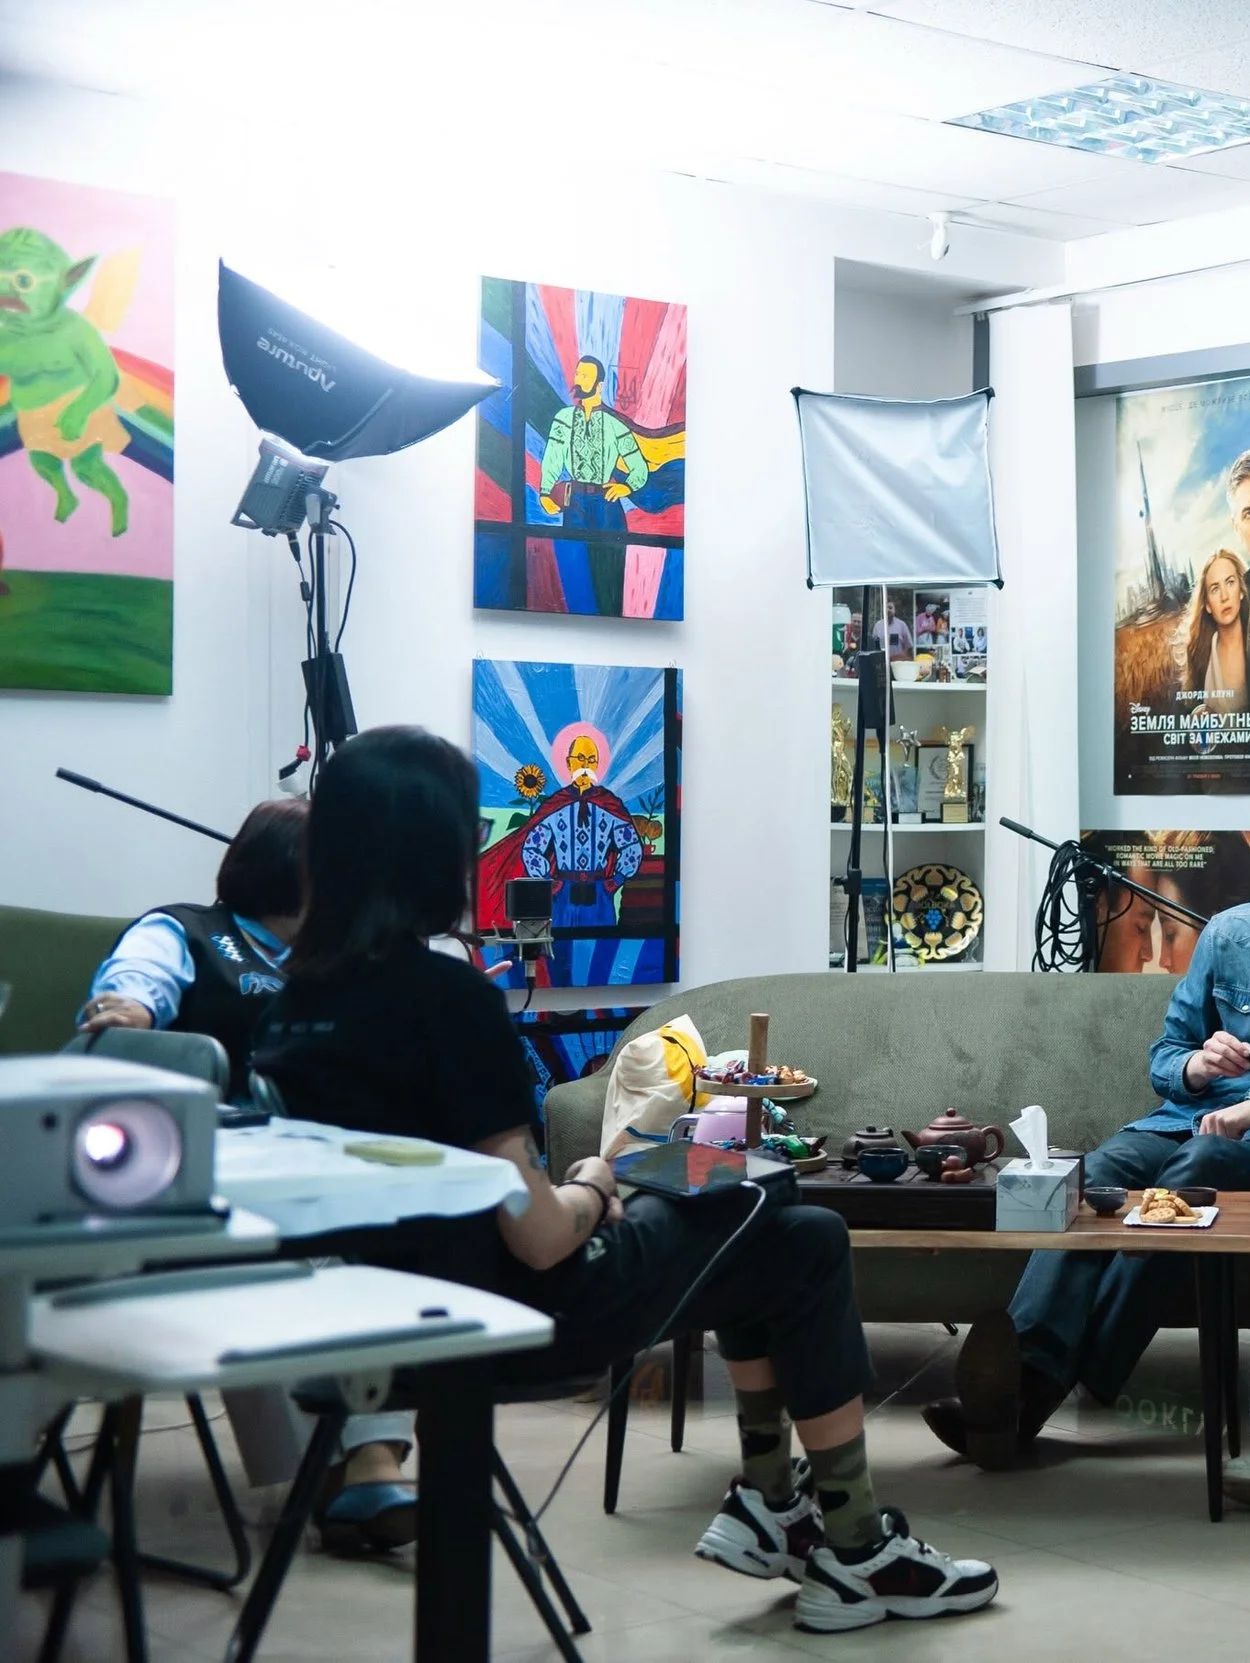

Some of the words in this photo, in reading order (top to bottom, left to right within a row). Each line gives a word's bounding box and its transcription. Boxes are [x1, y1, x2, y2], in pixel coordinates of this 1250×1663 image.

[257, 336, 336, 393] Aputure
[1176, 691, 1209, 701] ДЖОРДЖ
[1211, 689, 1234, 699] КЛУНІ
[1130, 714, 1175, 731] ЗЕМЛЯ
[1163, 733, 1186, 745] СВІТ
[1189, 733, 1202, 744] ЗА
